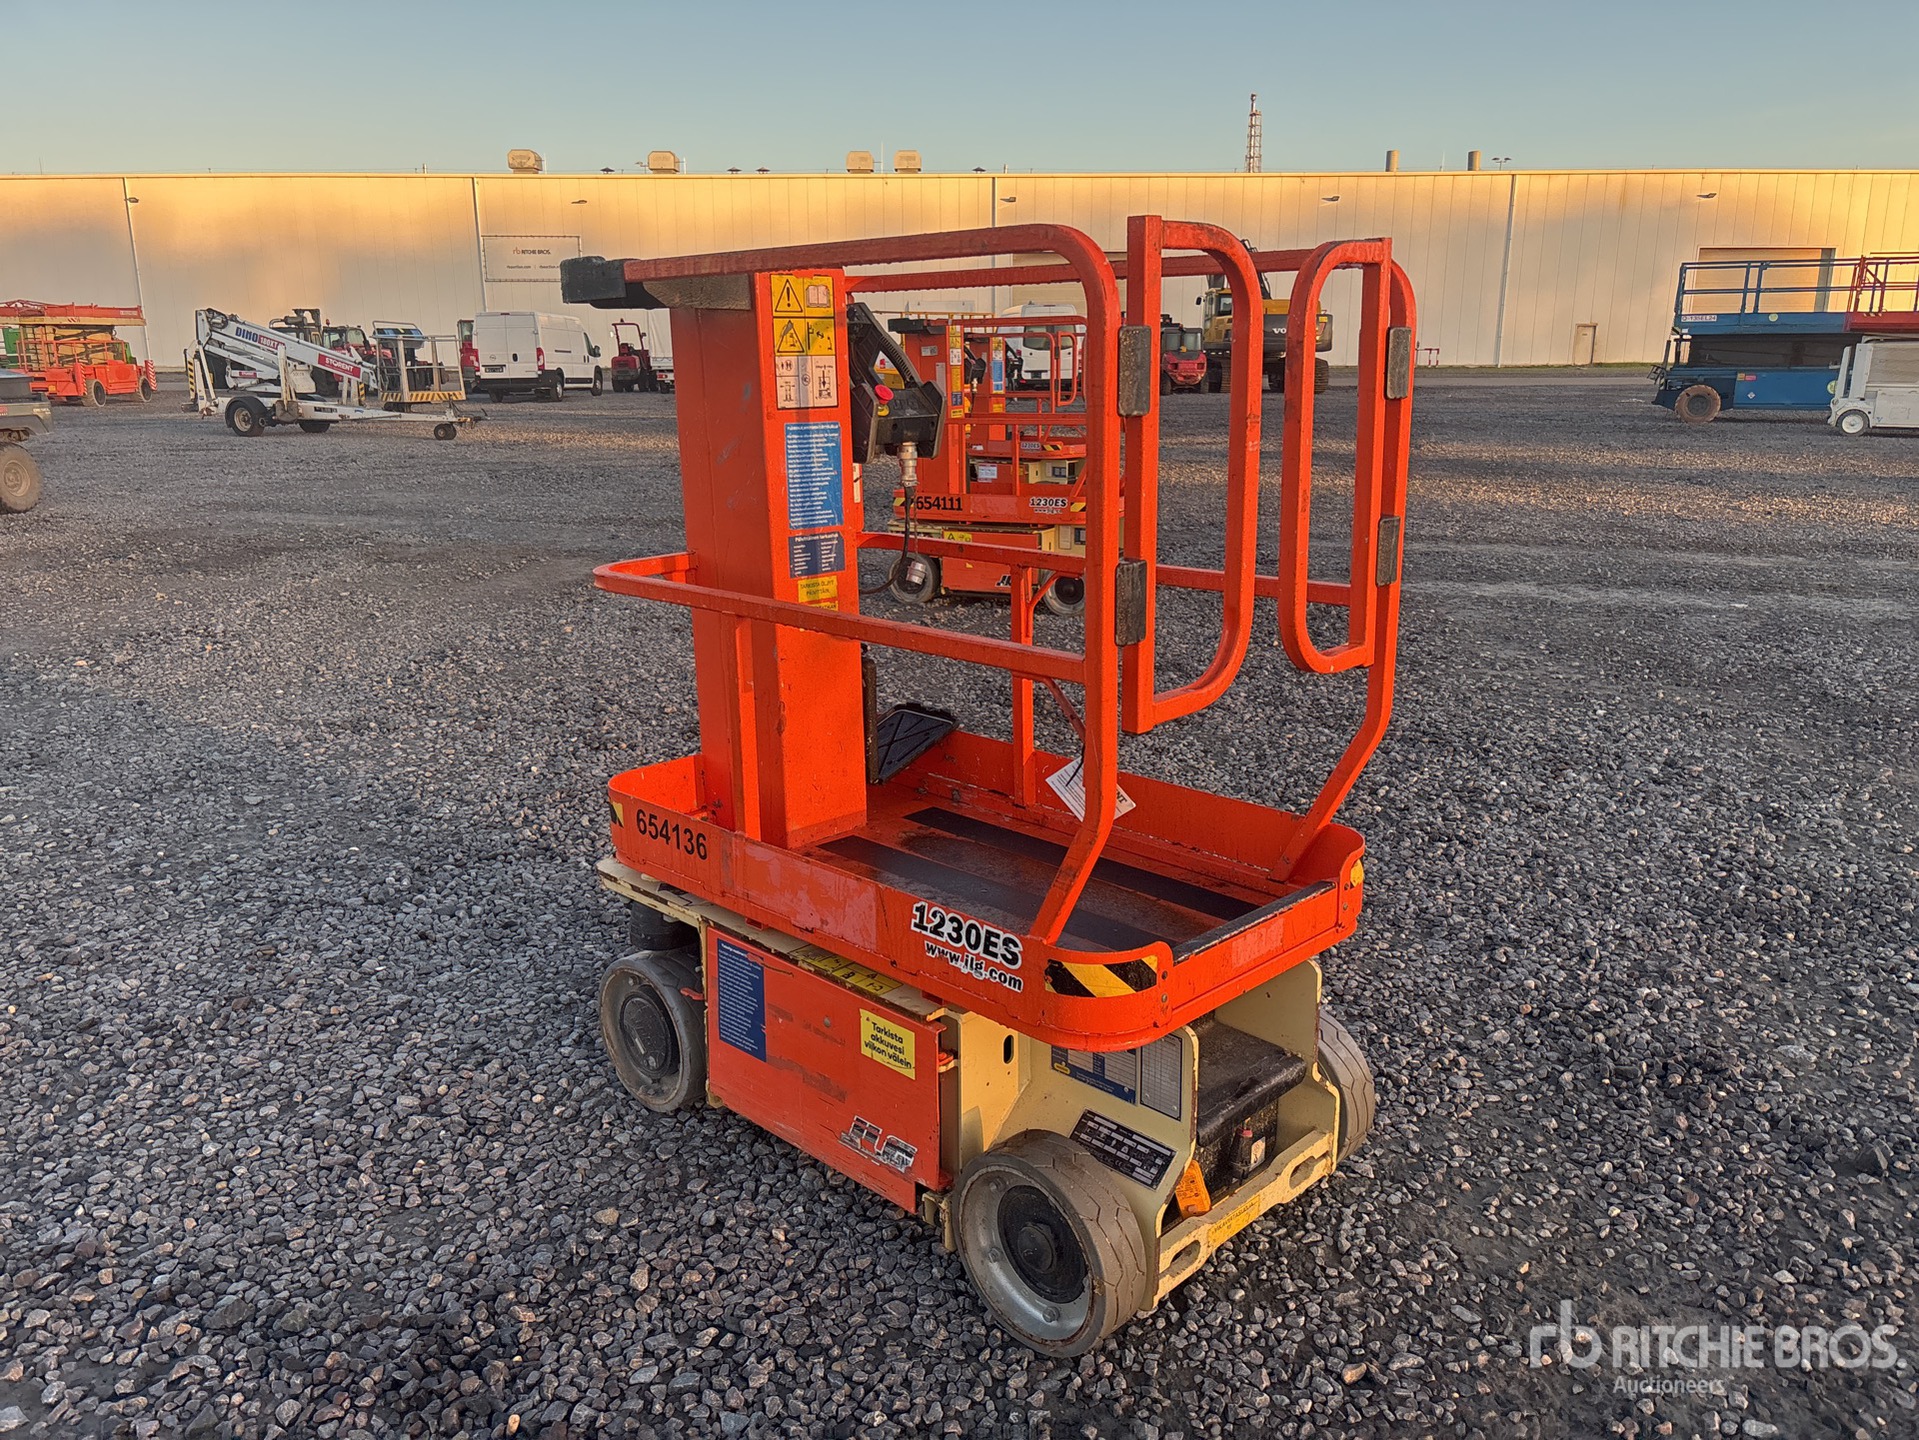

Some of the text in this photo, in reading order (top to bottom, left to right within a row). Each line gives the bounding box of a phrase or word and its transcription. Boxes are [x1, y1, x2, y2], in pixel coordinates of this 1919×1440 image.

[235, 326, 258, 342] DINO
[325, 357, 354, 372] STORENT
[916, 496, 963, 511] 654111
[1029, 497, 1068, 507] 1230ES
[636, 808, 707, 860] 654136
[911, 901, 1022, 969] 1230ES
[871, 1021, 903, 1044] Tarkista
[864, 1040, 912, 1069] viikon välein
[870, 1033, 904, 1055] akkuvesi
